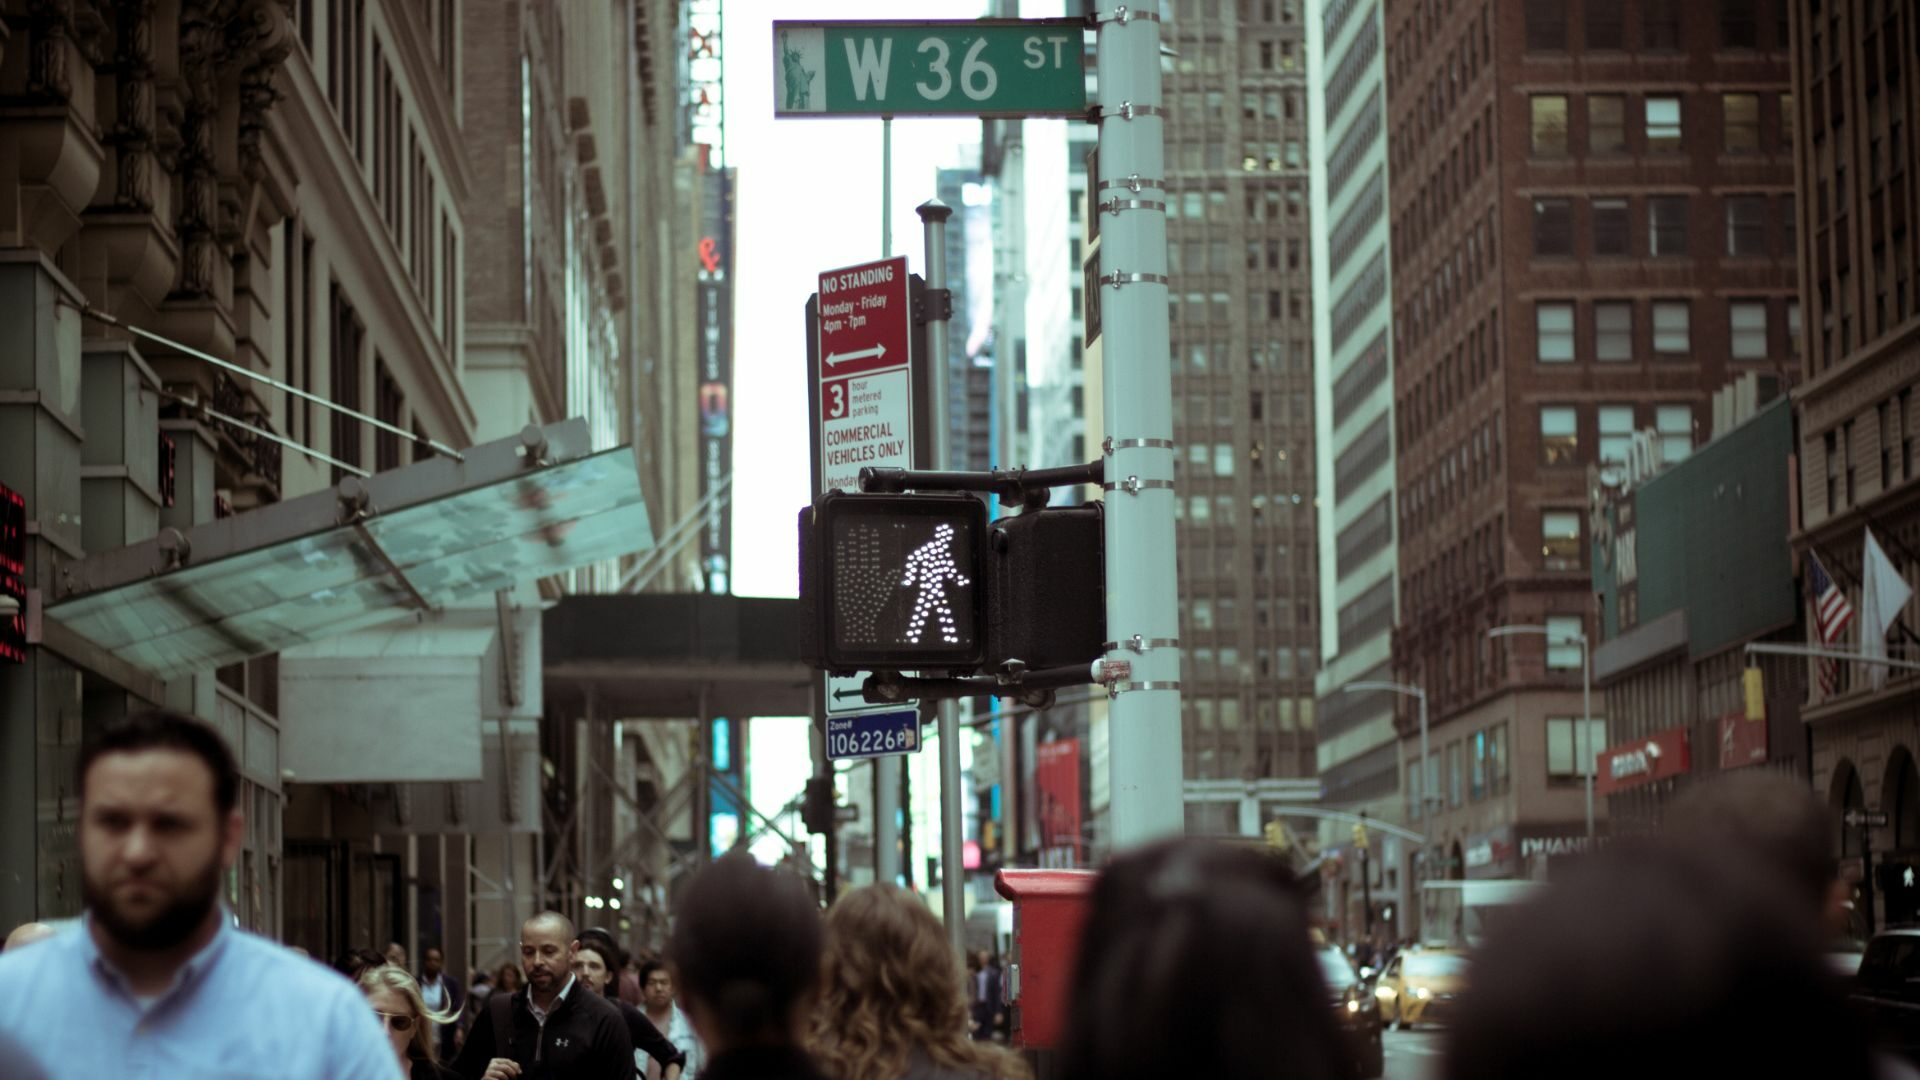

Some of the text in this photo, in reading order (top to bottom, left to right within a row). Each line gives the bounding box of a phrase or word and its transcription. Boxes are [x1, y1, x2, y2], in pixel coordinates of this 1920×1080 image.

[843, 36, 1068, 101] W 36 ST
[822, 265, 893, 295] NO STANDING
[823, 301, 854, 316] Monday
[861, 295, 887, 310] Friday
[824, 320, 842, 334] 4pm
[848, 315, 866, 330] 7pm
[852, 381, 868, 391] hour
[830, 383, 844, 418] 3
[852, 390, 882, 404] metered
[852, 404, 879, 418] parking
[827, 422, 893, 446] COMMERCIAL
[827, 440, 904, 466] VEHICLES ONLY
[827, 475, 858, 488] Monday
[830, 720, 853, 731] Zone#
